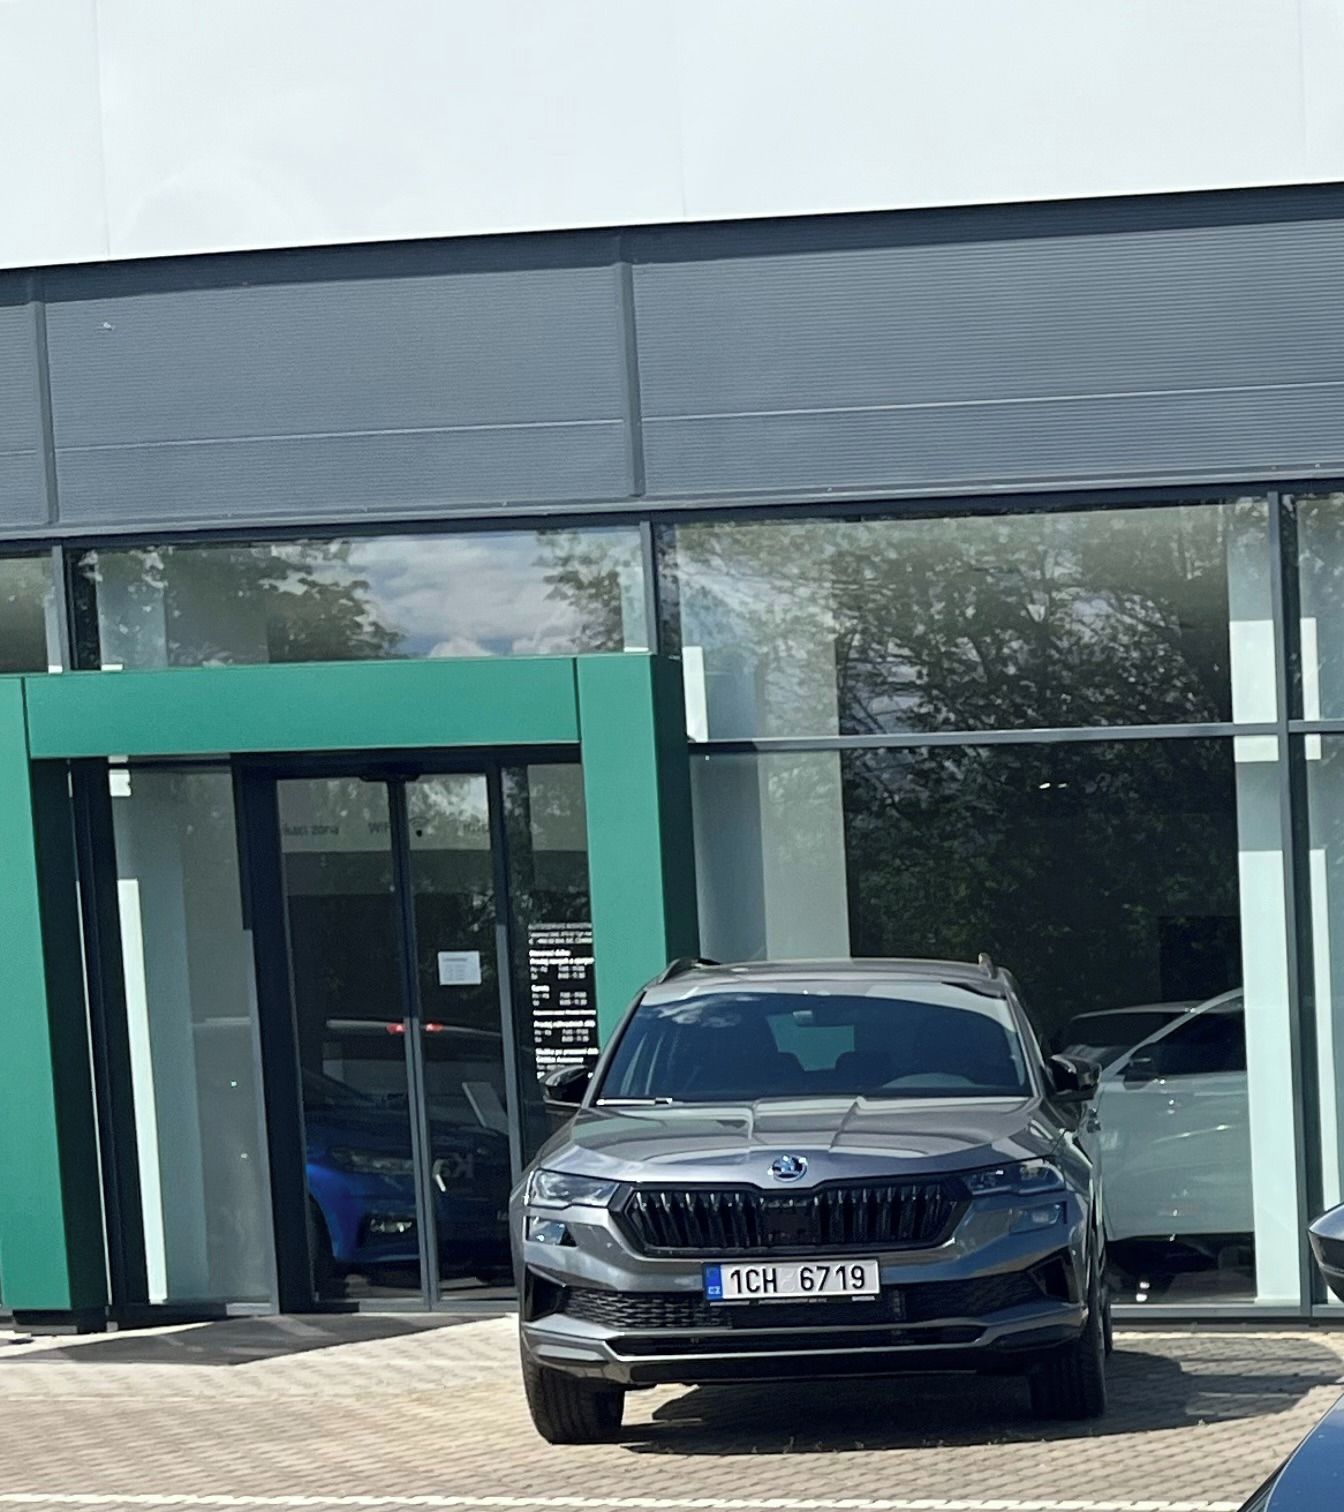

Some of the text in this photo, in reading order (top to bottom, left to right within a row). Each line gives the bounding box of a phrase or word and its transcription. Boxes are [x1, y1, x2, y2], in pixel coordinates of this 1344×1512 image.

[707, 1265, 866, 1295] CZ 1CH 6719
